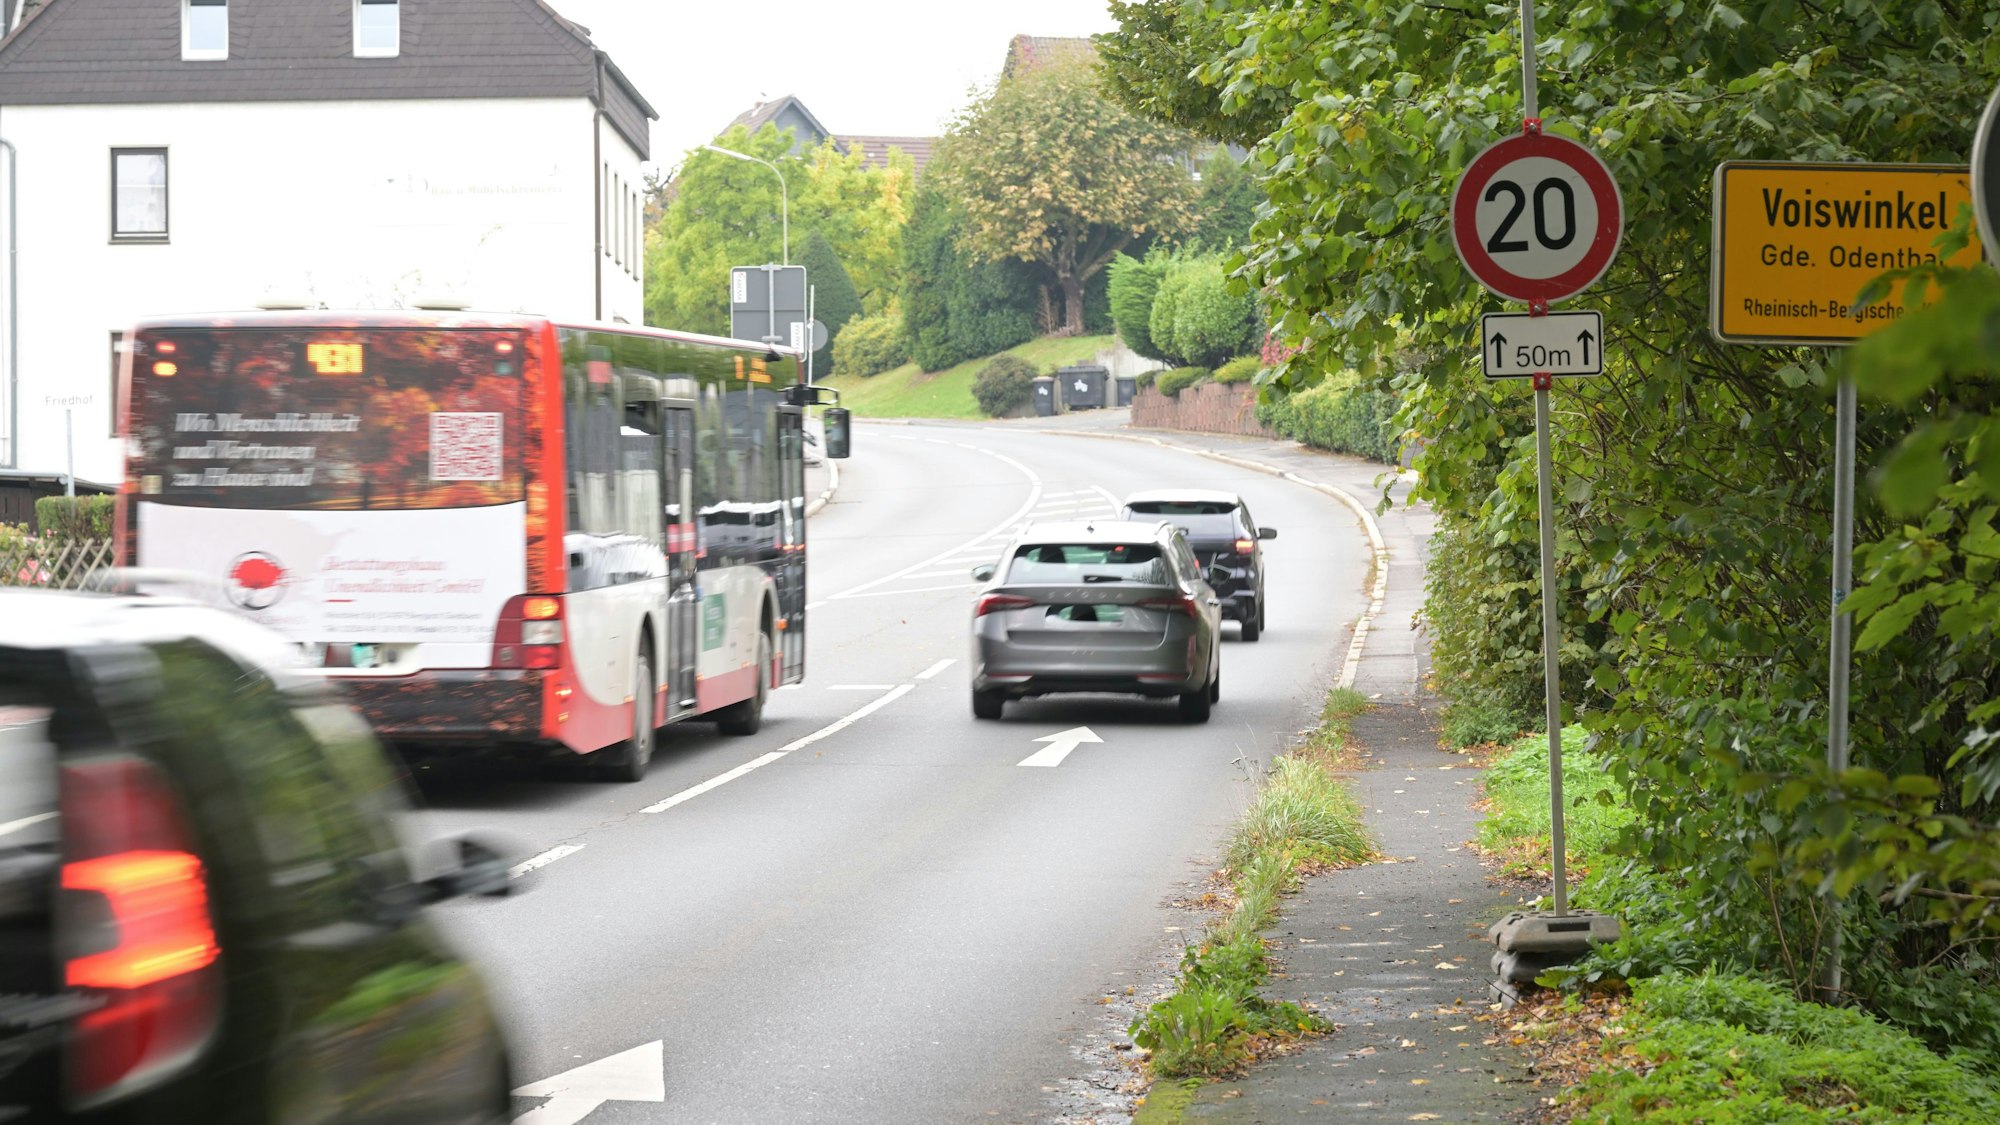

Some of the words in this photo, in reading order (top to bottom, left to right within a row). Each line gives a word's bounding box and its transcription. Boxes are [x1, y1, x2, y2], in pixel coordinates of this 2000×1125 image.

[1484, 177, 1577, 253] 20
[1762, 188, 1948, 230] Voiswinkel
[1761, 244, 1816, 267] Gde.
[1516, 345, 1571, 367] 50m
[45, 394, 93, 406] Friedhof
